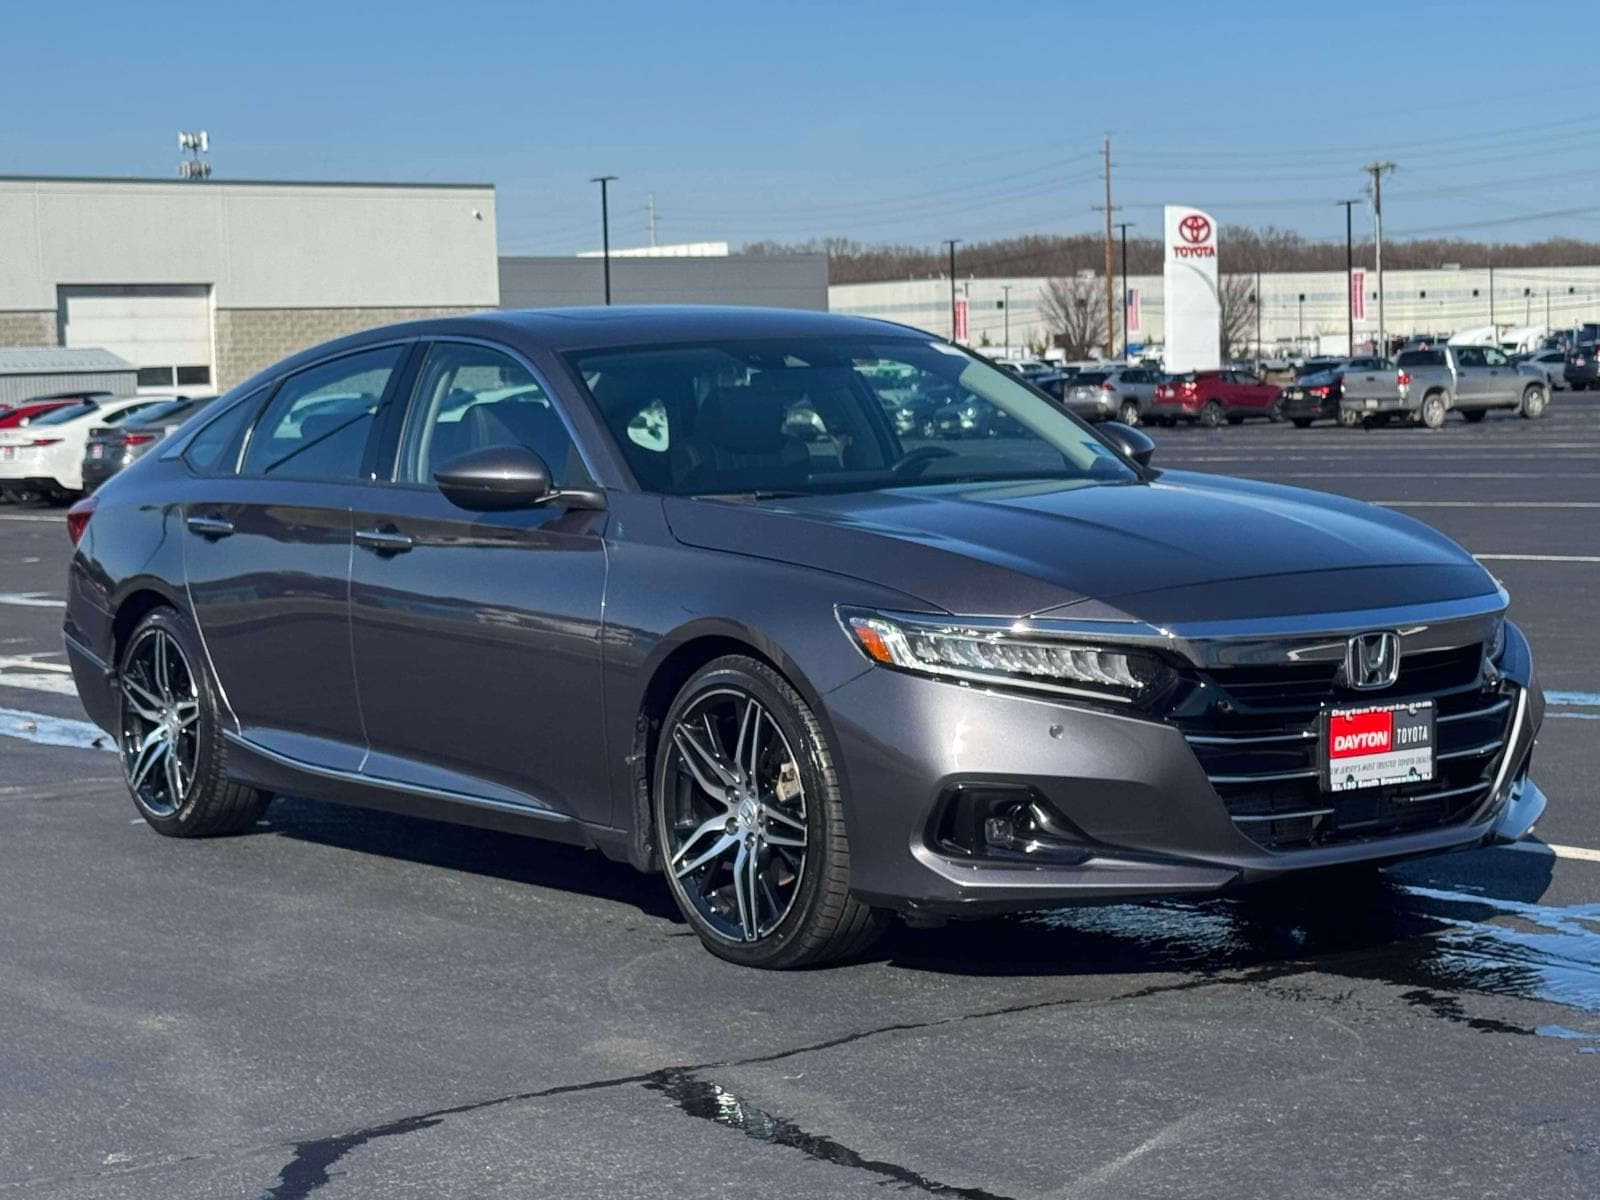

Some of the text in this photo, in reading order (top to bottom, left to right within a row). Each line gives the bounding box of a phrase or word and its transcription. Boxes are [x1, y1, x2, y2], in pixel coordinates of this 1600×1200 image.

[1174, 246, 1216, 258] TOYOTA
[1334, 726, 1428, 752] DAYTON TOYOTA
